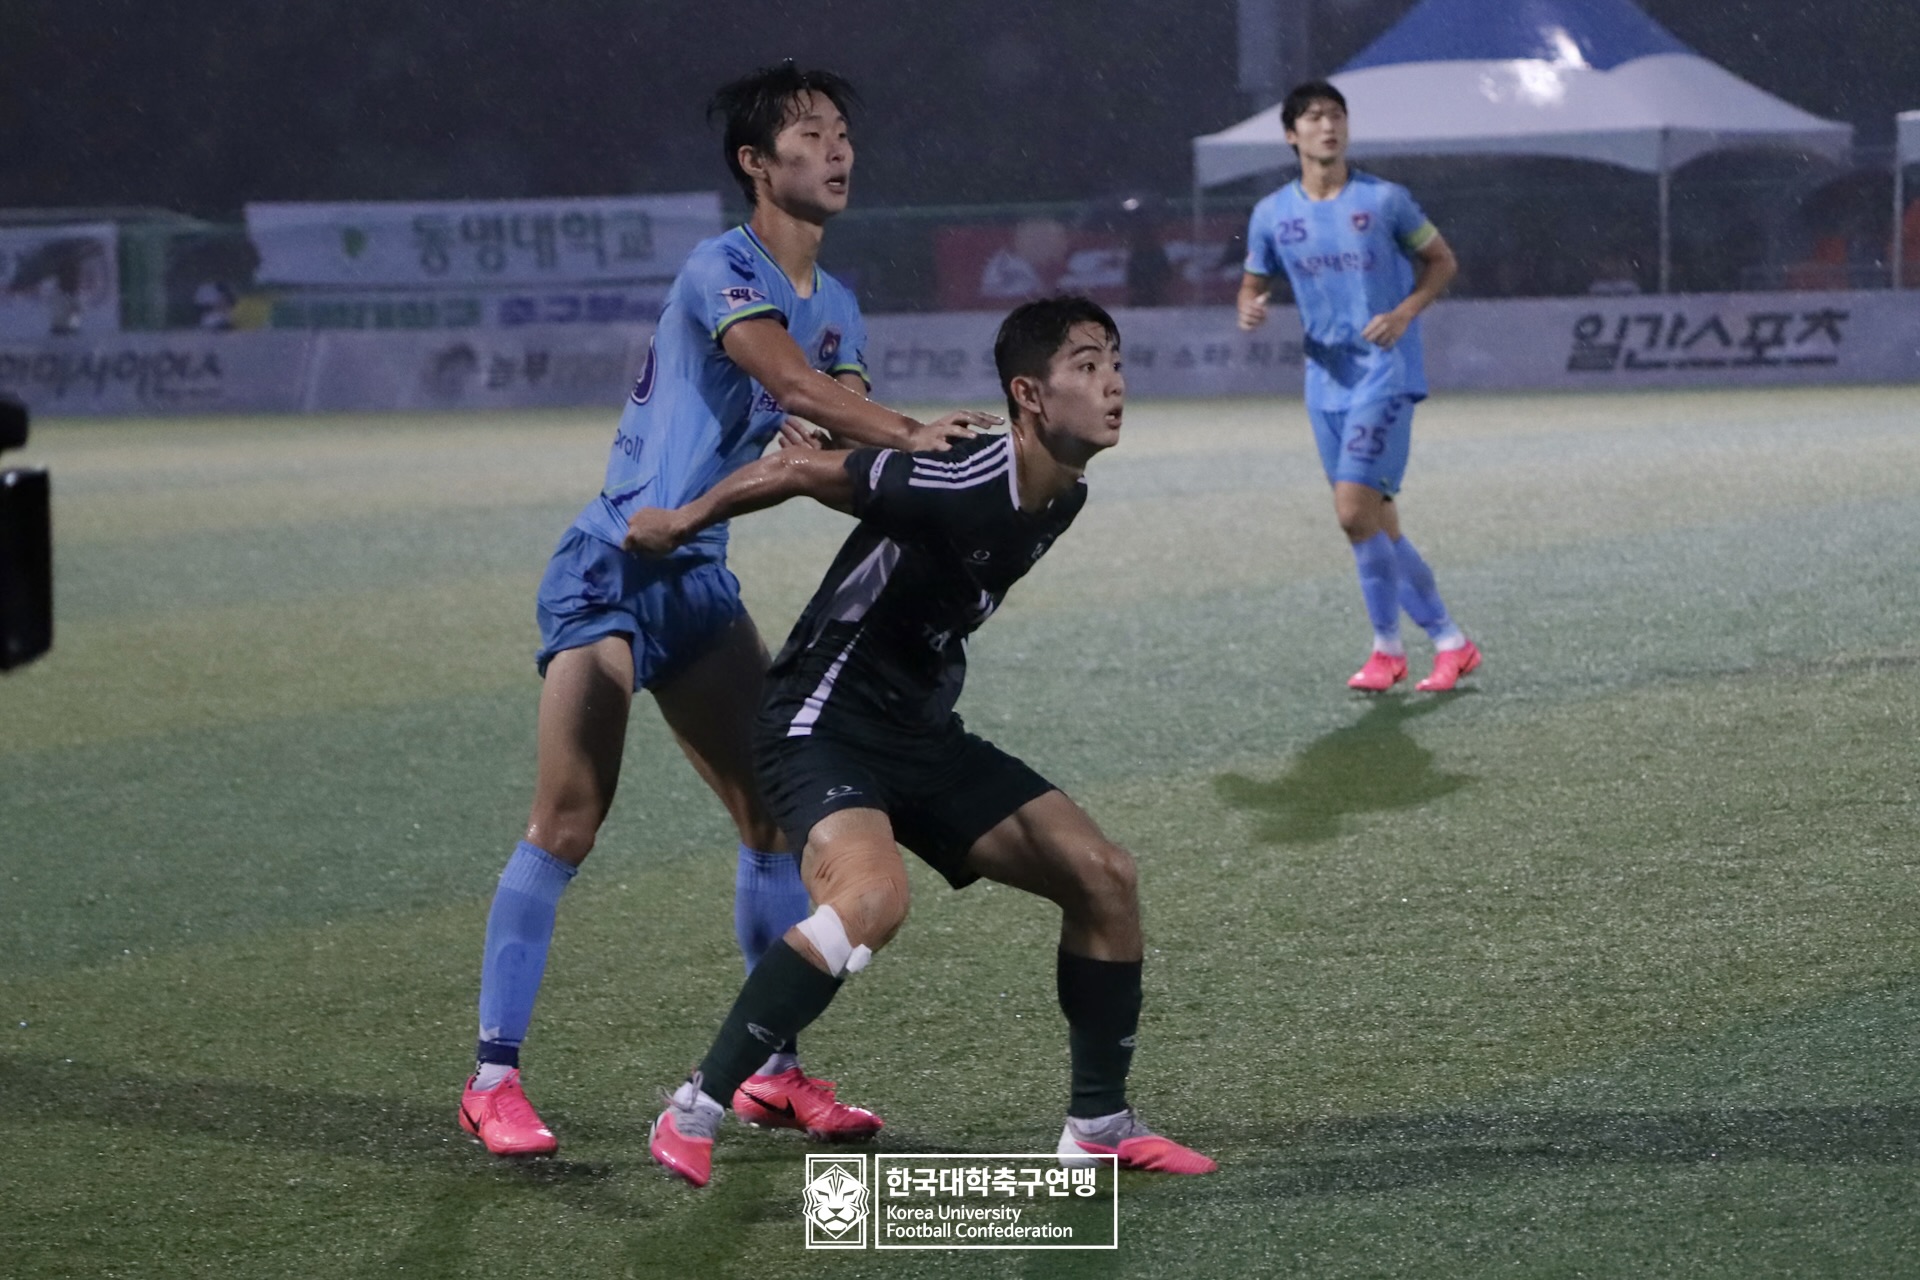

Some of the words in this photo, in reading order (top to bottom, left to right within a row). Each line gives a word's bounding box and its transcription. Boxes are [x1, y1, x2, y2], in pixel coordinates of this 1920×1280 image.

[411, 210, 654, 276] 동명대학교
[1278, 217, 1308, 246] 25
[1566, 307, 1851, 372] 일간스포츠
[1346, 423, 1387, 457] 25
